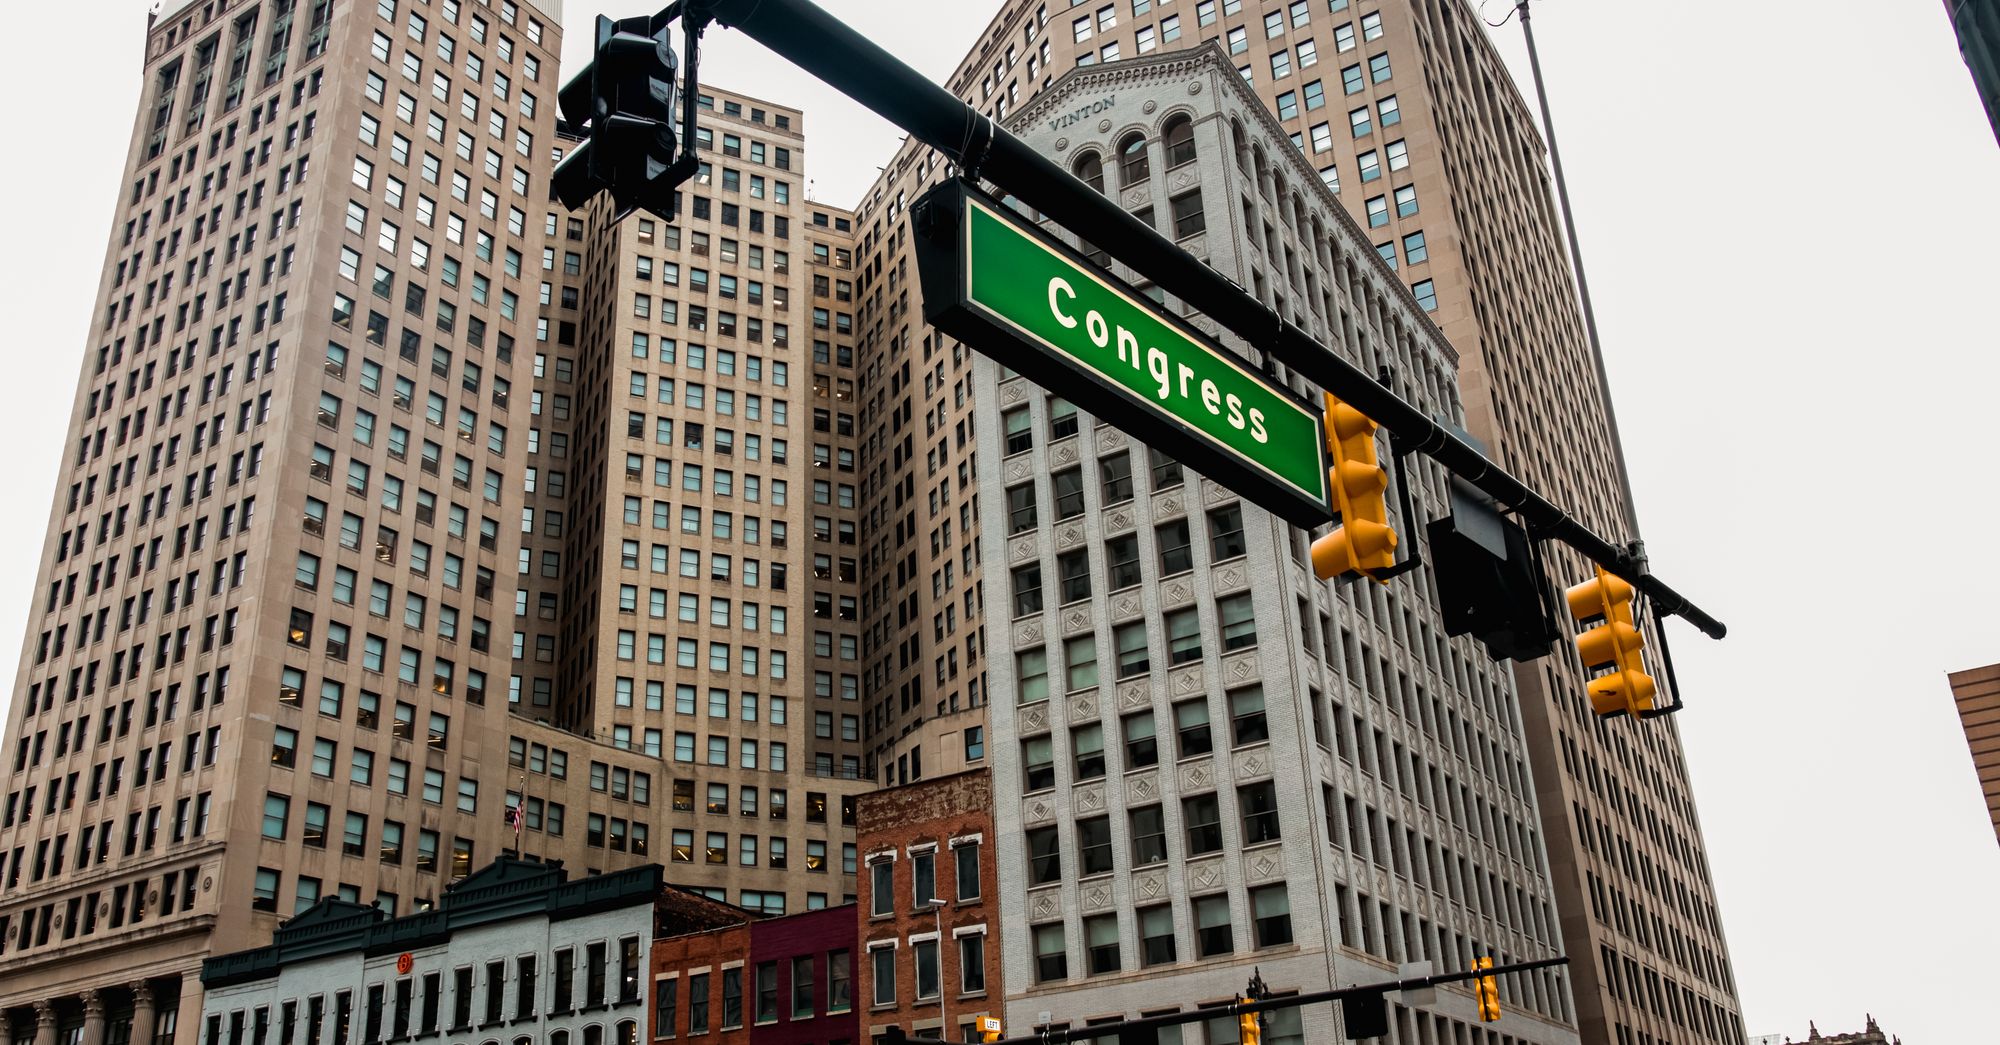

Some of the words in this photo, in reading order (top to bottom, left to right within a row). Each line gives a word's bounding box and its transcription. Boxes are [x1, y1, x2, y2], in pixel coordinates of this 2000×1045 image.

[1049, 95, 1115, 131] VINTON
[1048, 277, 1268, 444] Congress
[986, 1020, 998, 1029] LEFT
